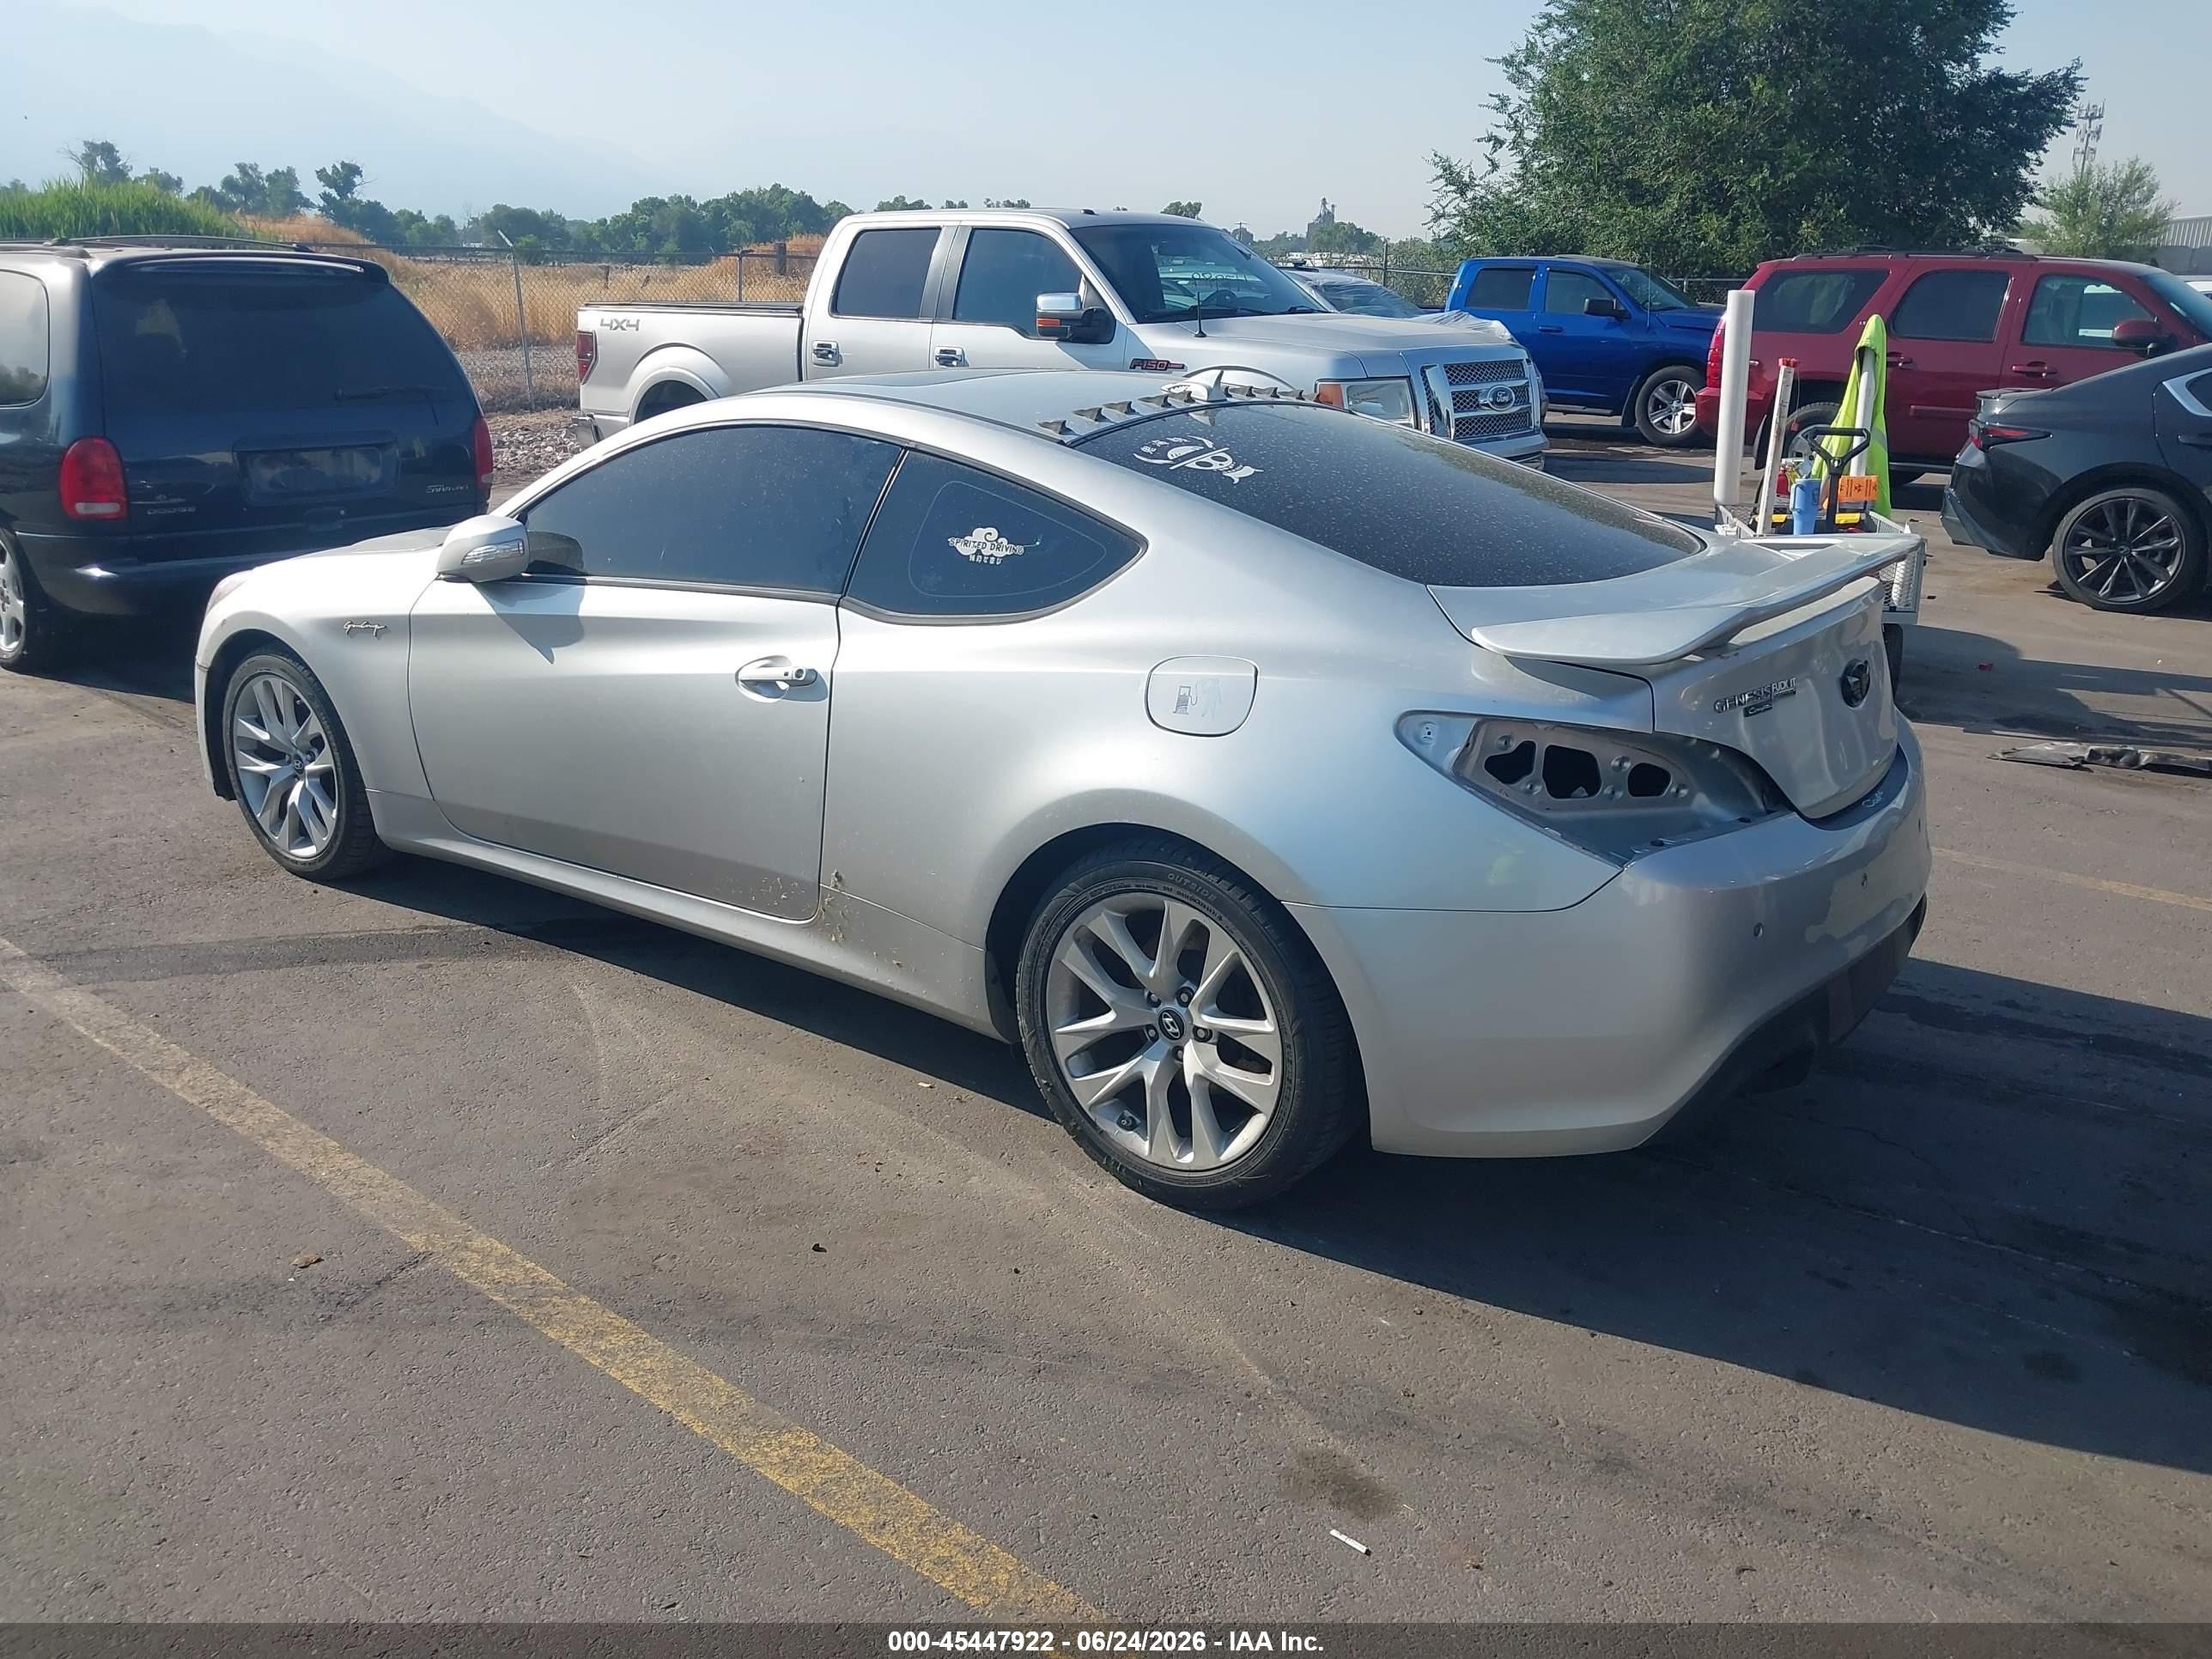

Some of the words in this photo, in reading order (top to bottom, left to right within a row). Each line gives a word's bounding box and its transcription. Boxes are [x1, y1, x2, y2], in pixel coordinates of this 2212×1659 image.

[147, 507, 197, 515] DODGE
[948, 537, 988, 550] SPIRITED
[989, 542, 1024, 556] DRIVING
[1714, 685, 1771, 714] GENESIS
